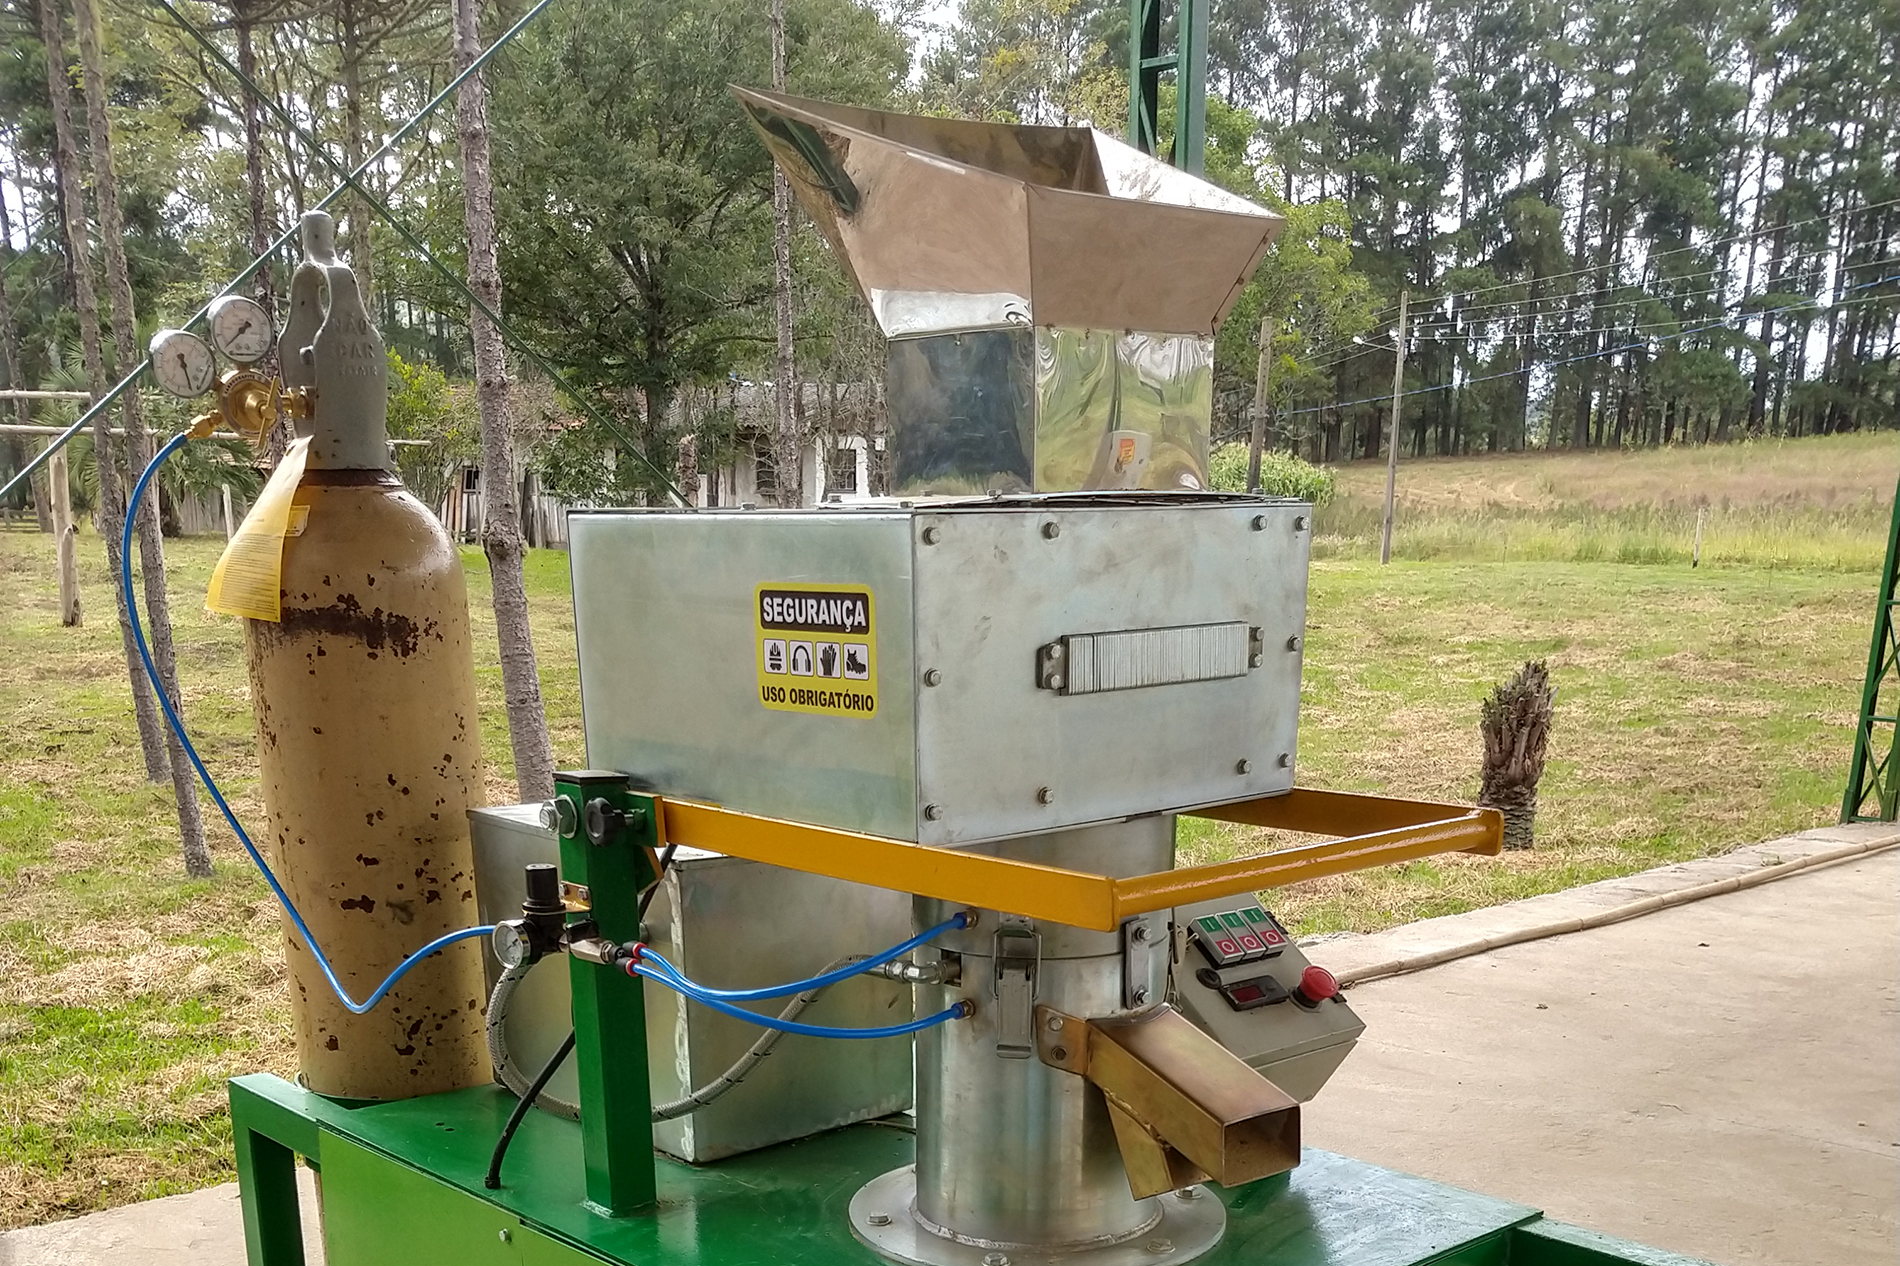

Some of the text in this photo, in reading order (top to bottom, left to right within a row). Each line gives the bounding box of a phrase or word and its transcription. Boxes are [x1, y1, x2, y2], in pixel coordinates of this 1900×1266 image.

[762, 596, 867, 633] SEGURANÇA
[762, 685, 874, 712] USO OBRIGATÓRIO
